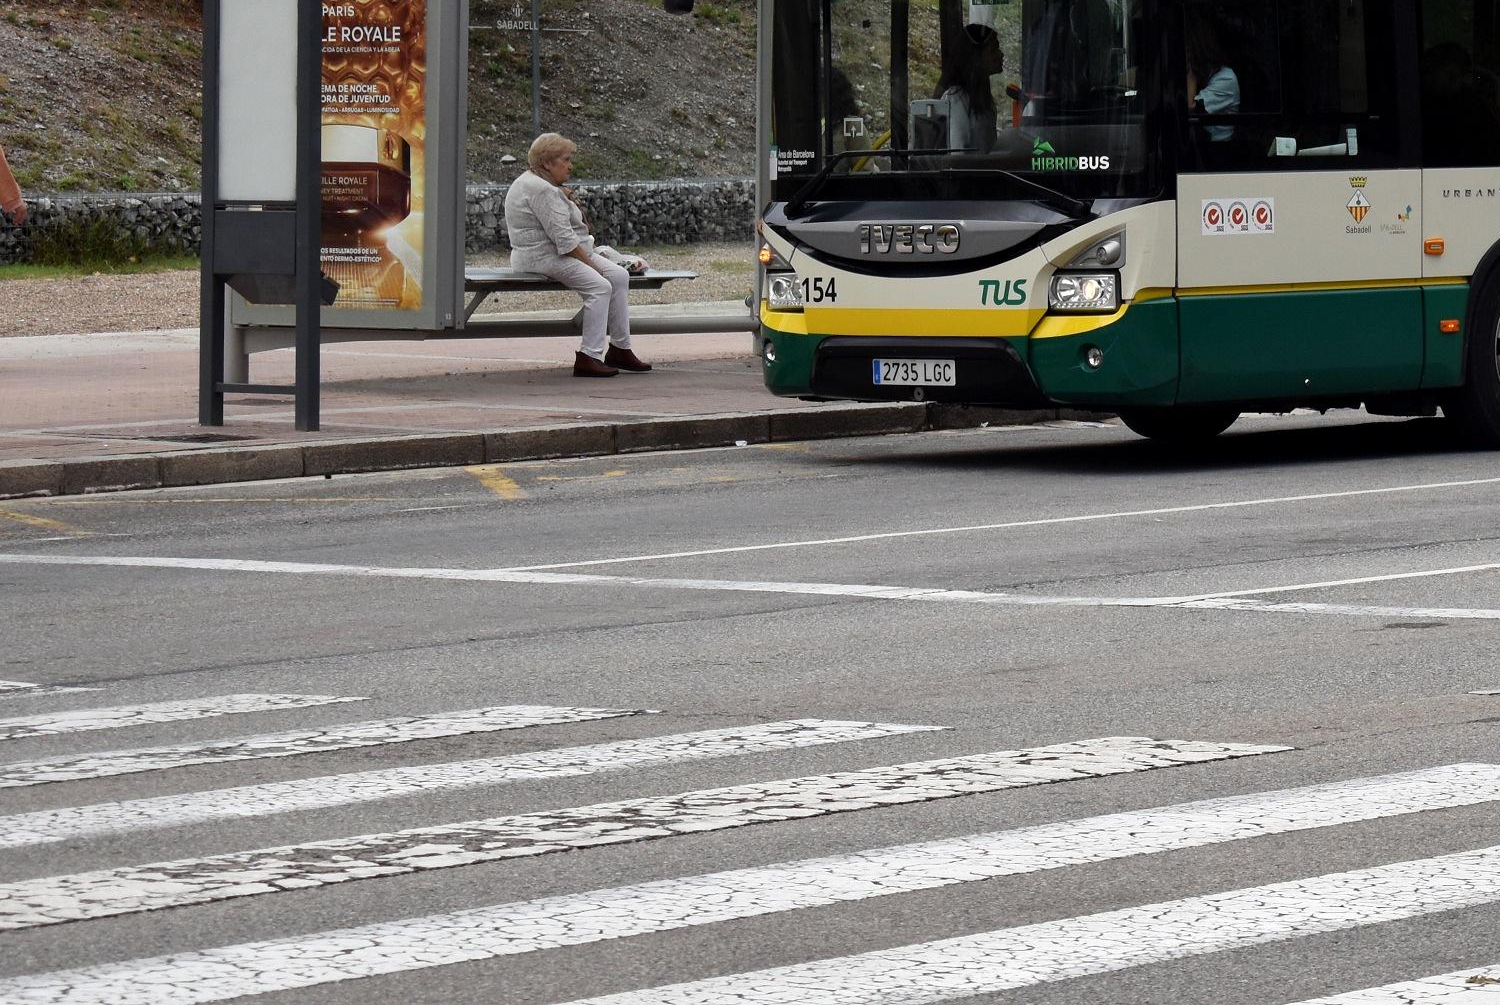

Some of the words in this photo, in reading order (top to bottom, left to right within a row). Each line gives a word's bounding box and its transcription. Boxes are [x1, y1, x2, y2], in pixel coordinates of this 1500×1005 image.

[322, 5, 355, 17] PARIS
[341, 26, 401, 42] ROYALE
[338, 84, 349, 93] DE
[350, 84, 377, 93] NOCHE
[338, 94, 349, 103] DE
[350, 94, 391, 103] JUVENTUD
[793, 150, 815, 158] Barcelona
[1031, 156, 1110, 171] HIBRIDBUS
[338, 177, 368, 185] ROYALE
[1345, 225, 1372, 234] Sabadell
[860, 224, 961, 254] IVECO
[801, 277, 838, 303] 154
[978, 279, 1027, 306] TUS
[883, 362, 919, 382] 2735
[924, 363, 951, 382] LGC
